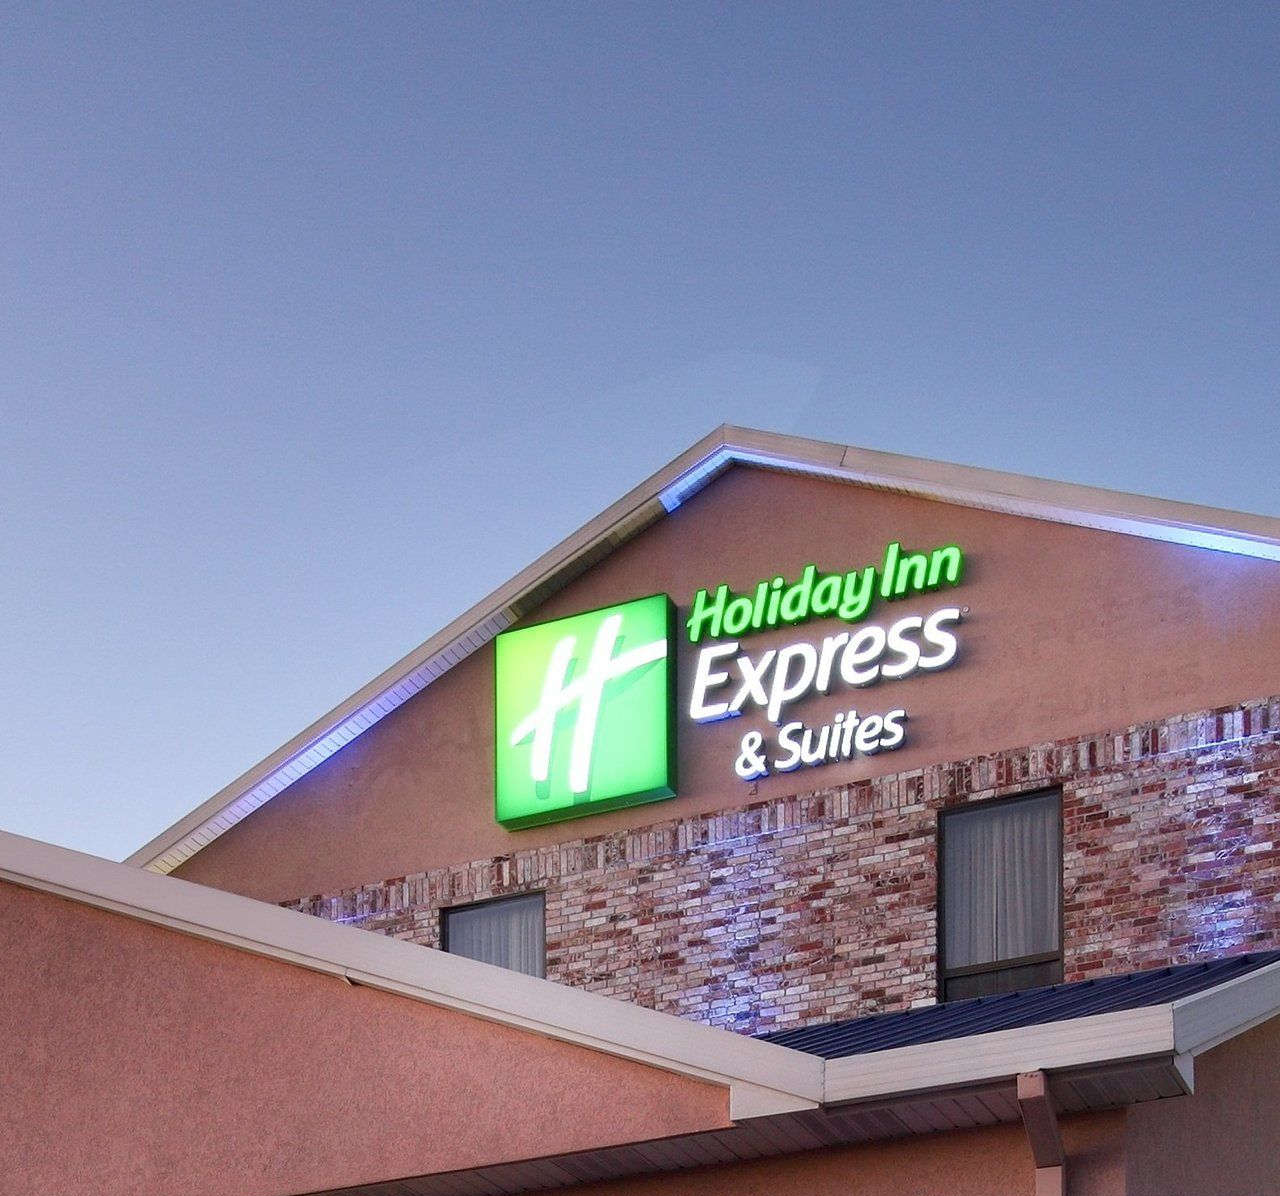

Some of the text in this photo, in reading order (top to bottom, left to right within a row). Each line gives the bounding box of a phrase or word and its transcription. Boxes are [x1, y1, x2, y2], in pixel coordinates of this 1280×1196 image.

[686, 540, 963, 644] Holiday Inn
[510, 614, 668, 793] H
[689, 608, 962, 724] Express
[734, 709, 907, 780] & Suites
